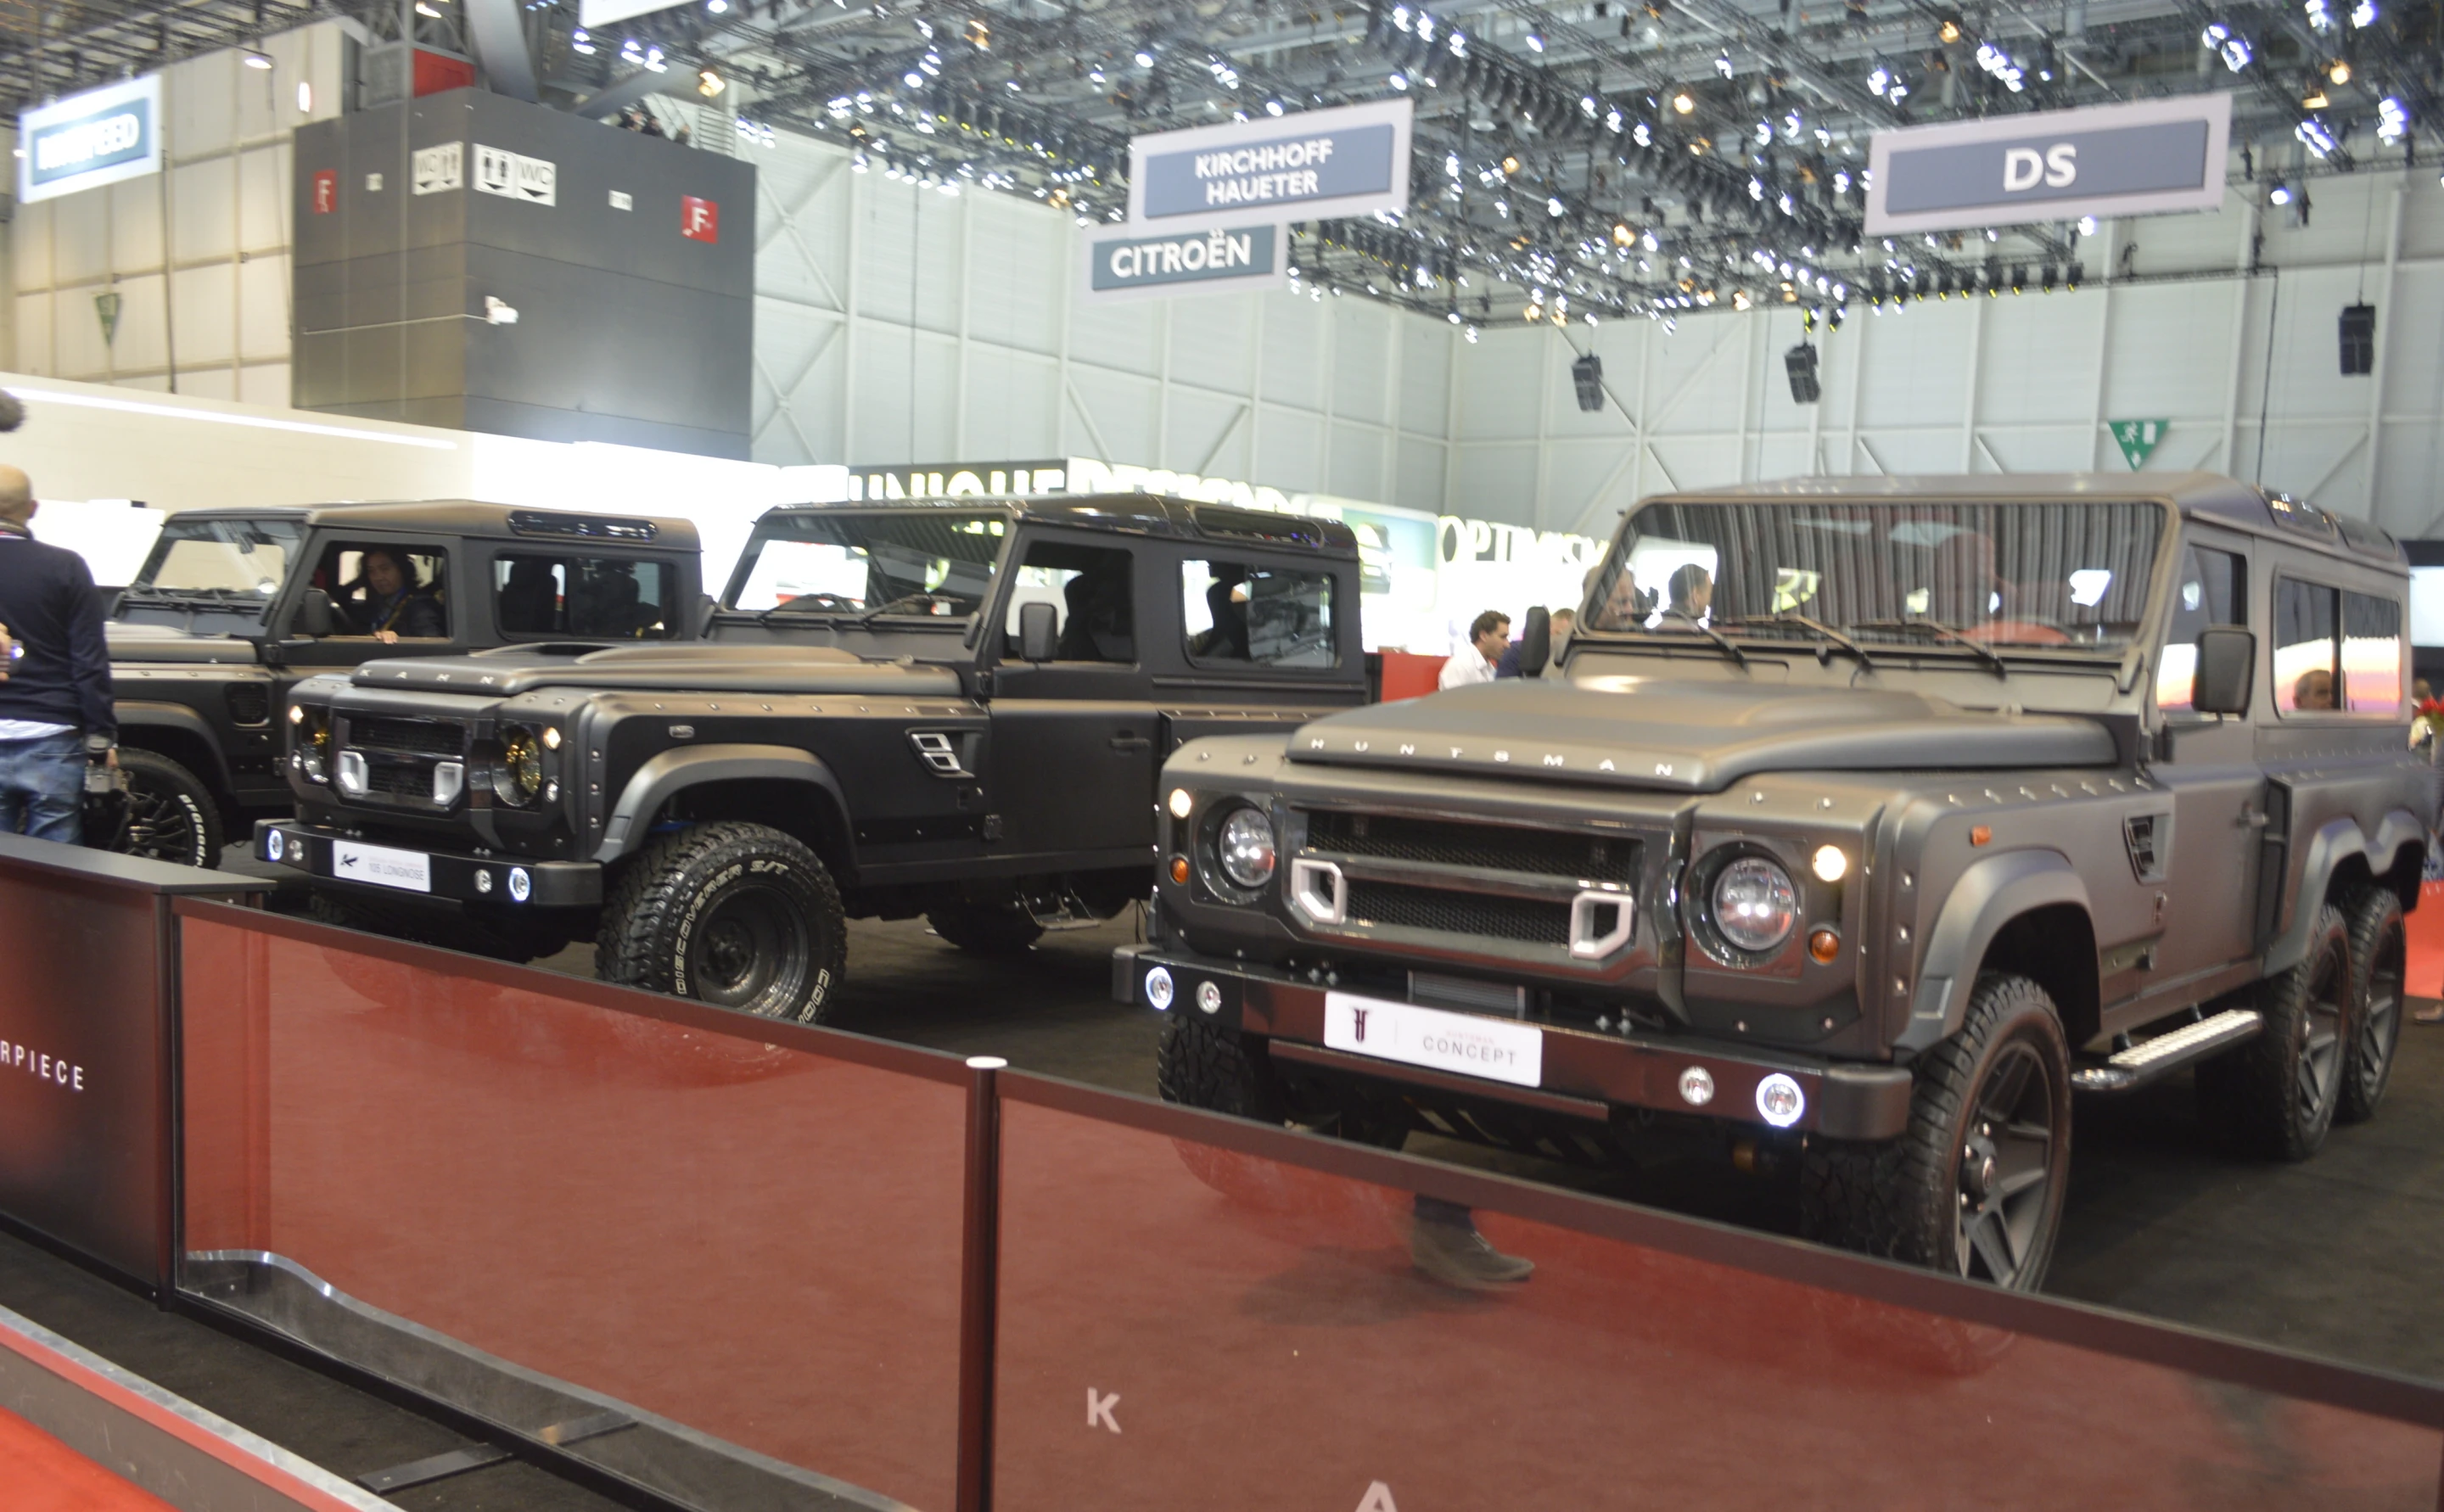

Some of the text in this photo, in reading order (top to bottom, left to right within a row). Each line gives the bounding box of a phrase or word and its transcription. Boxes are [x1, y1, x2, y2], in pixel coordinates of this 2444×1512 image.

[518, 160, 554, 185] WC
[1195, 138, 1333, 178] KIRCHHOFF
[2004, 143, 2077, 192] DS
[1206, 170, 1319, 204] HAUETER
[692, 206, 709, 232] F
[1110, 227, 1251, 277] CITROËN
[1310, 738, 1673, 776] HUNTSMAN
[675, 860, 789, 994] DISCOVERER S/T
[0, 1040, 83, 1090] RPIECE
[1423, 1036, 1516, 1066] CONCEPT
